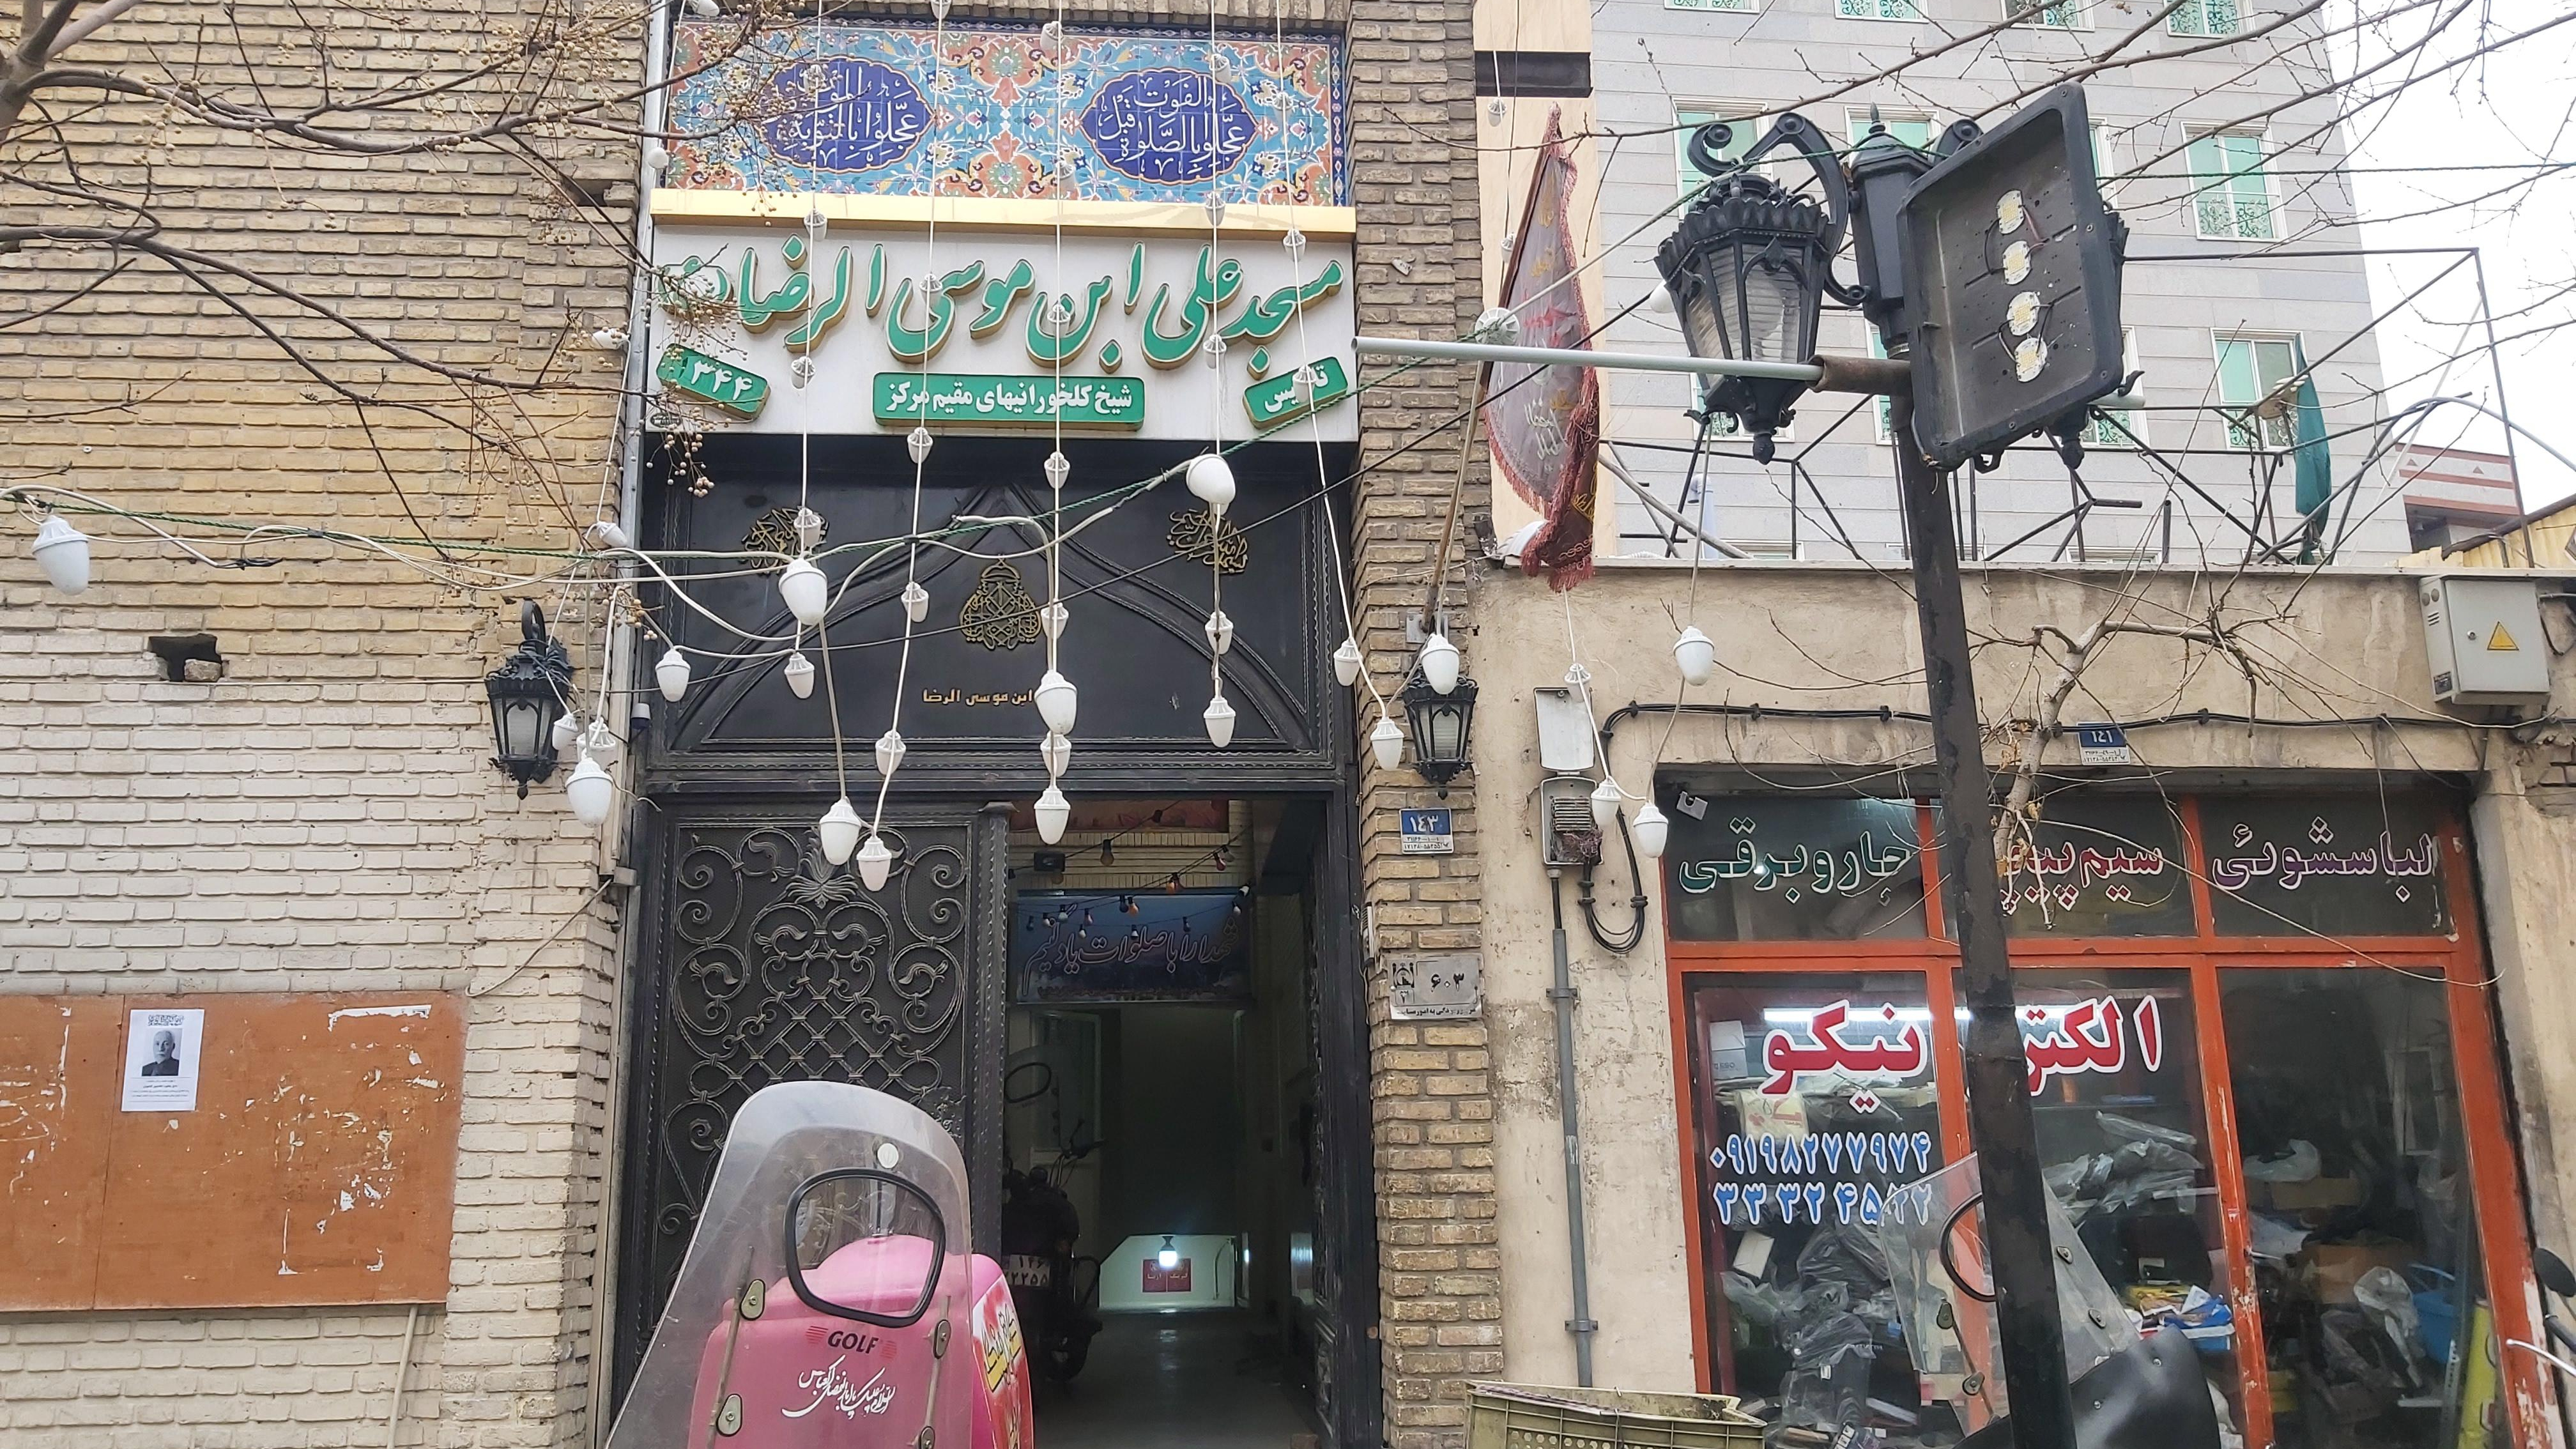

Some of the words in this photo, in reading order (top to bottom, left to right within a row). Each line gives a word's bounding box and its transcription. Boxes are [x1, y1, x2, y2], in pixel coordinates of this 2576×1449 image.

[886, 257, 1036, 358] موسی
[1025, 241, 1146, 367] ابن
[1141, 243, 1244, 364] علی
[1216, 259, 1344, 374] مسجد
[886, 381, 930, 411] مرکز
[933, 381, 973, 413] مقیم
[1094, 383, 1133, 415] شیخ
[922, 688, 961, 705] الرضا
[965, 692, 1009, 706] موسی
[1011, 688, 1033, 705] ابن
[2079, 847, 2164, 902] سیم
[1757, 998, 1929, 1114] نیکو
[827, 1331, 879, 1354] GOLF
